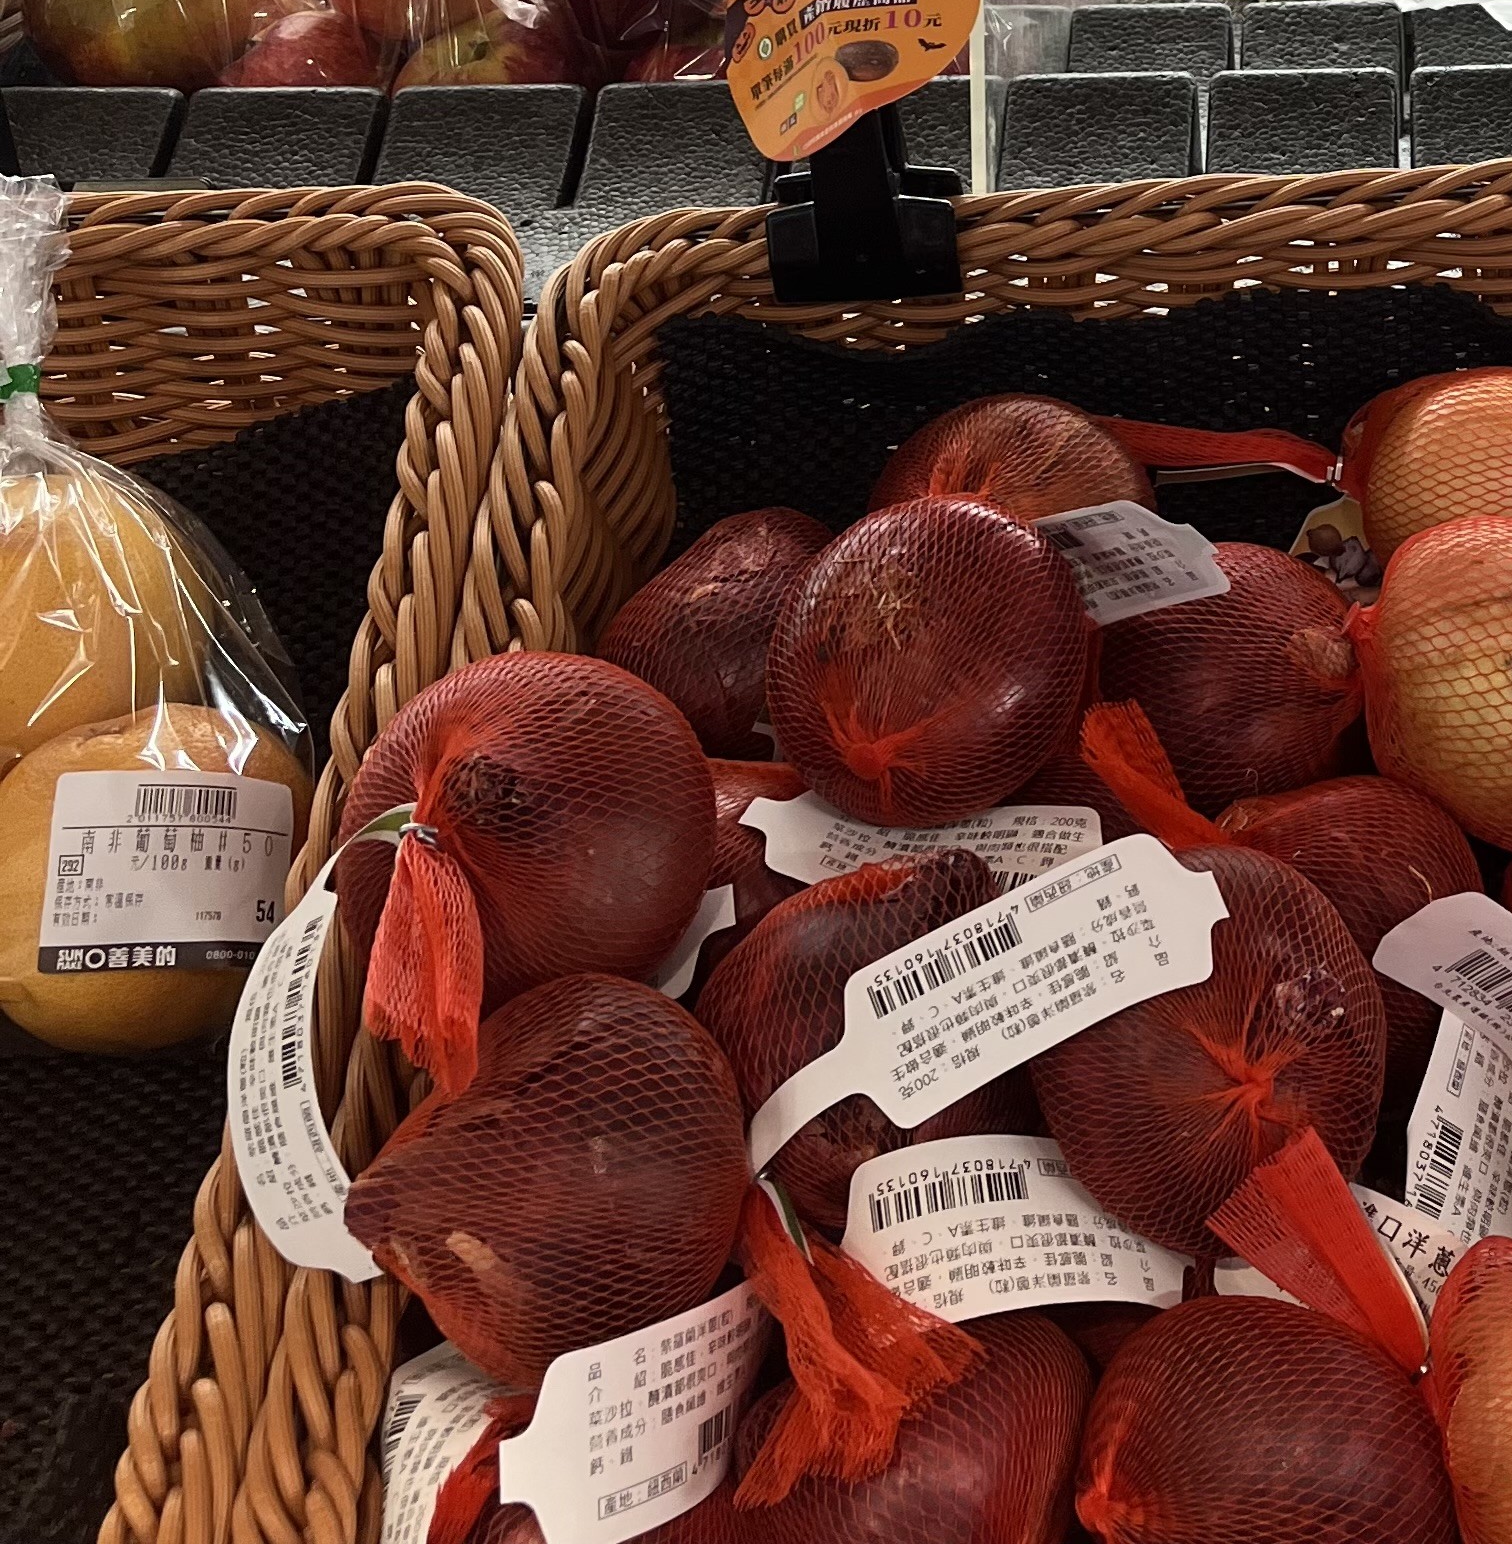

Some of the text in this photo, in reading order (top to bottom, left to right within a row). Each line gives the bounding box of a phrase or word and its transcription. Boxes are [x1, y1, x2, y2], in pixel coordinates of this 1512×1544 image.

[60, 859, 81, 873] 292
[255, 899, 276, 924] 54
[57, 948, 84, 962] SUN
[107, 944, 177, 969] 善美的
